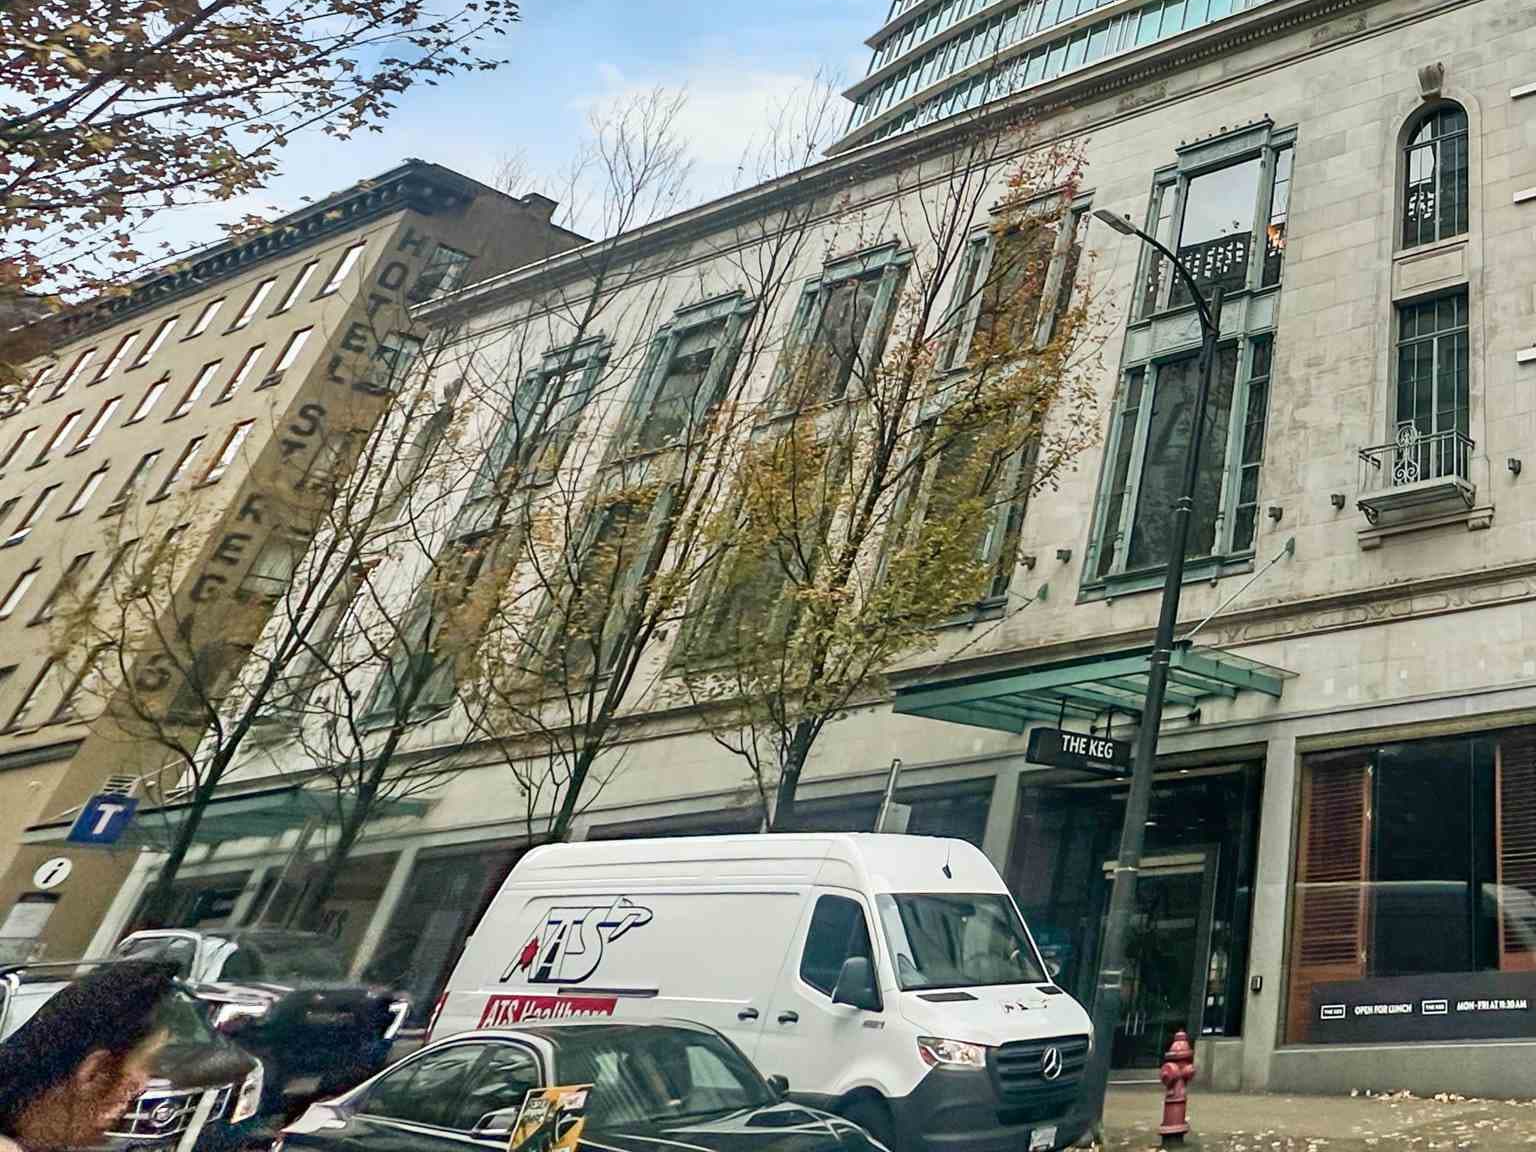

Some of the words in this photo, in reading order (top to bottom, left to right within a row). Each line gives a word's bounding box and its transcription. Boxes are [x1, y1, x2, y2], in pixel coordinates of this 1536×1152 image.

[1062, 734, 1088, 754] THE
[1089, 739, 1114, 759] KEG
[481, 999, 519, 1028] ATS
[1354, 1005, 1373, 1015] OPEN
